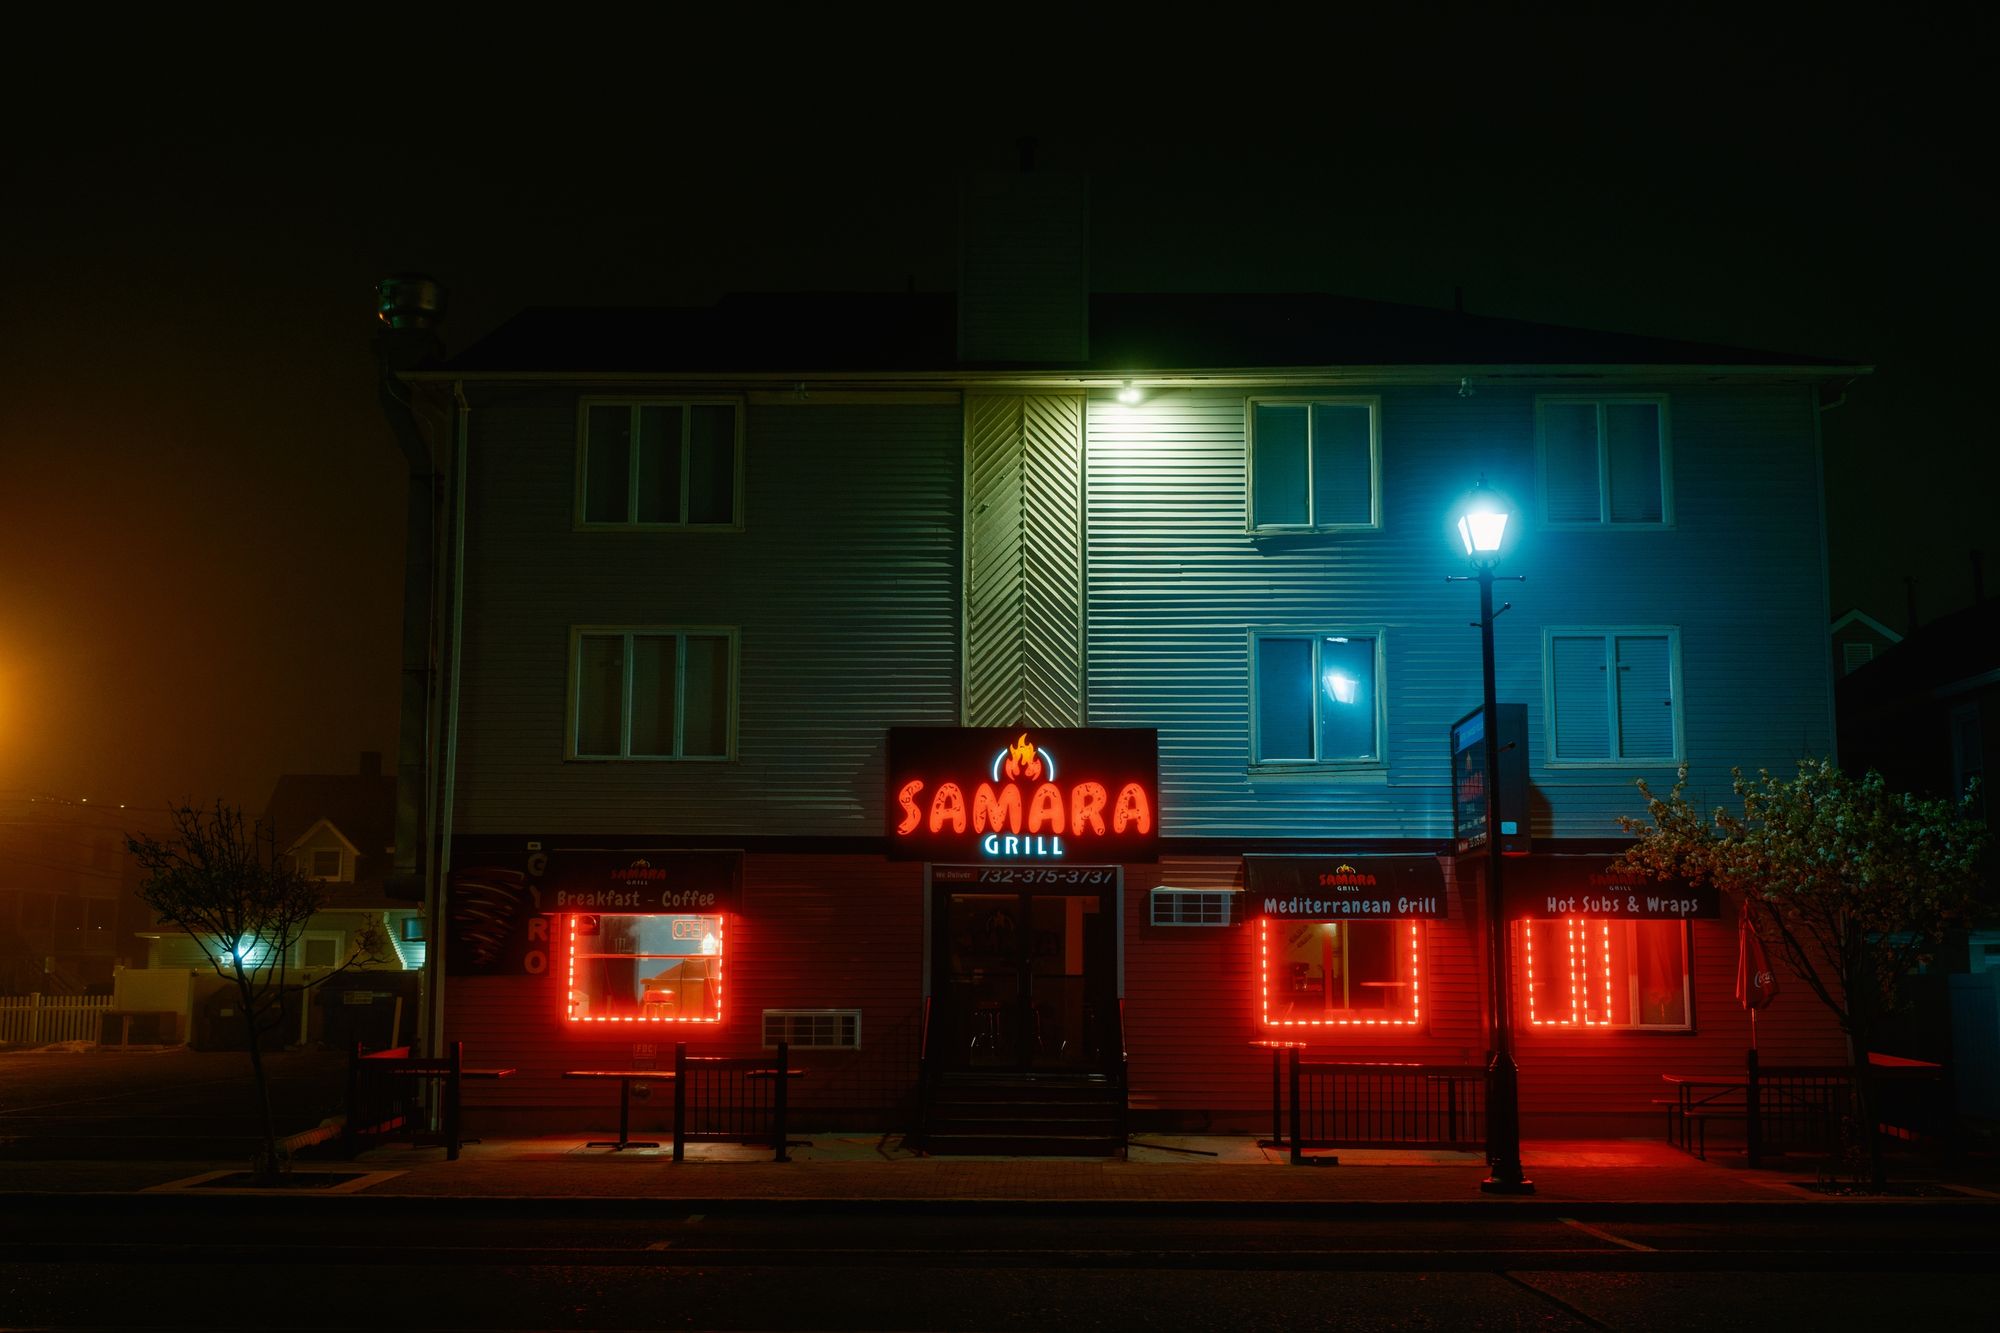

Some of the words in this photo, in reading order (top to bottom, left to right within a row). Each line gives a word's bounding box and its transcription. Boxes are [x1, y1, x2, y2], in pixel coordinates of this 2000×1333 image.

[897, 779, 1151, 837] SAMARA
[984, 834, 1063, 856] GRILL
[608, 868, 667, 881] SAMARA
[979, 868, 1113, 884] 732-375-3737
[1319, 873, 1377, 886] SAMARA
[557, 890, 640, 908] Breakfast
[662, 889, 716, 907] Coffee
[1264, 897, 1391, 914] Mediterranean
[1397, 897, 1436, 914] Grill
[1547, 896, 1576, 914] Hot
[1582, 896, 1620, 913] Subs
[1626, 896, 1640, 913] &
[1646, 896, 1700, 916] Wraps
[523, 852, 549, 975] GYRO
